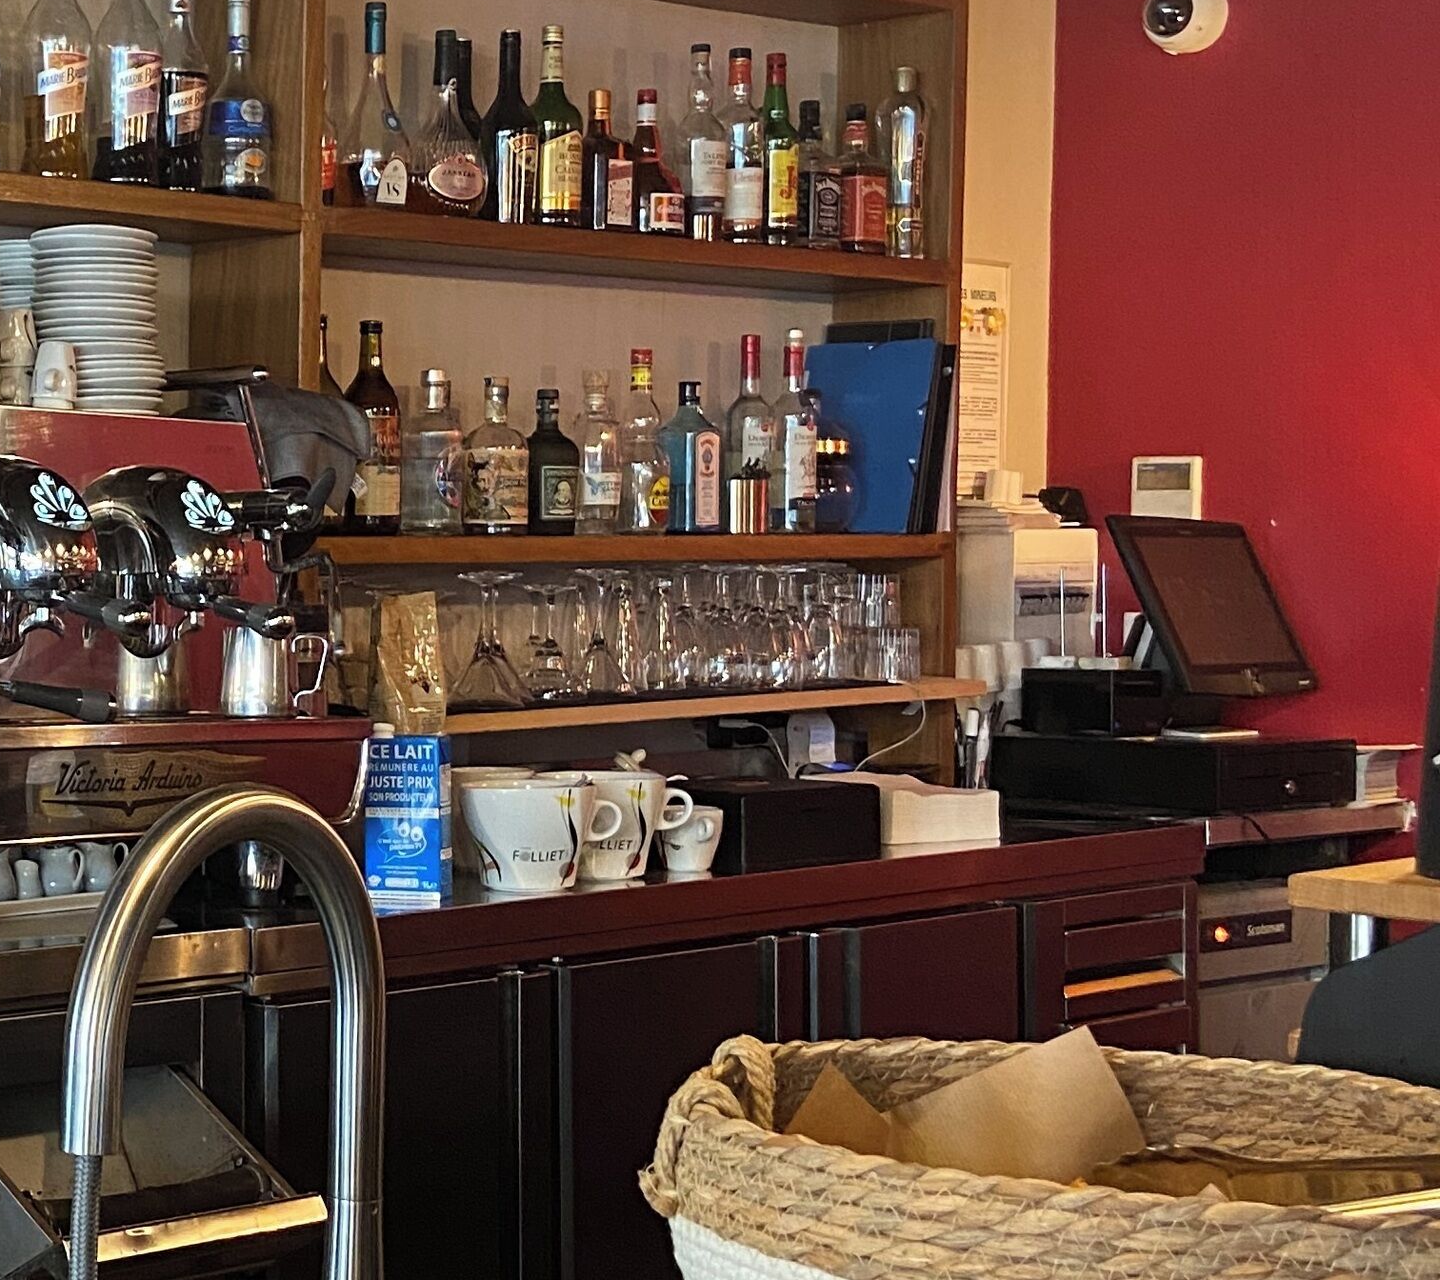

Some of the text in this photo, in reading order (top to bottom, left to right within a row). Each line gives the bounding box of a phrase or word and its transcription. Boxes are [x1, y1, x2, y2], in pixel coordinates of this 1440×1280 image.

[369, 744, 433, 760] CE LAIT
[420, 763, 434, 772] AU
[55, 759, 203, 795] Victoria Arduino
[370, 776, 433, 789] JUSTE PRIX
[369, 792, 384, 801] SON
